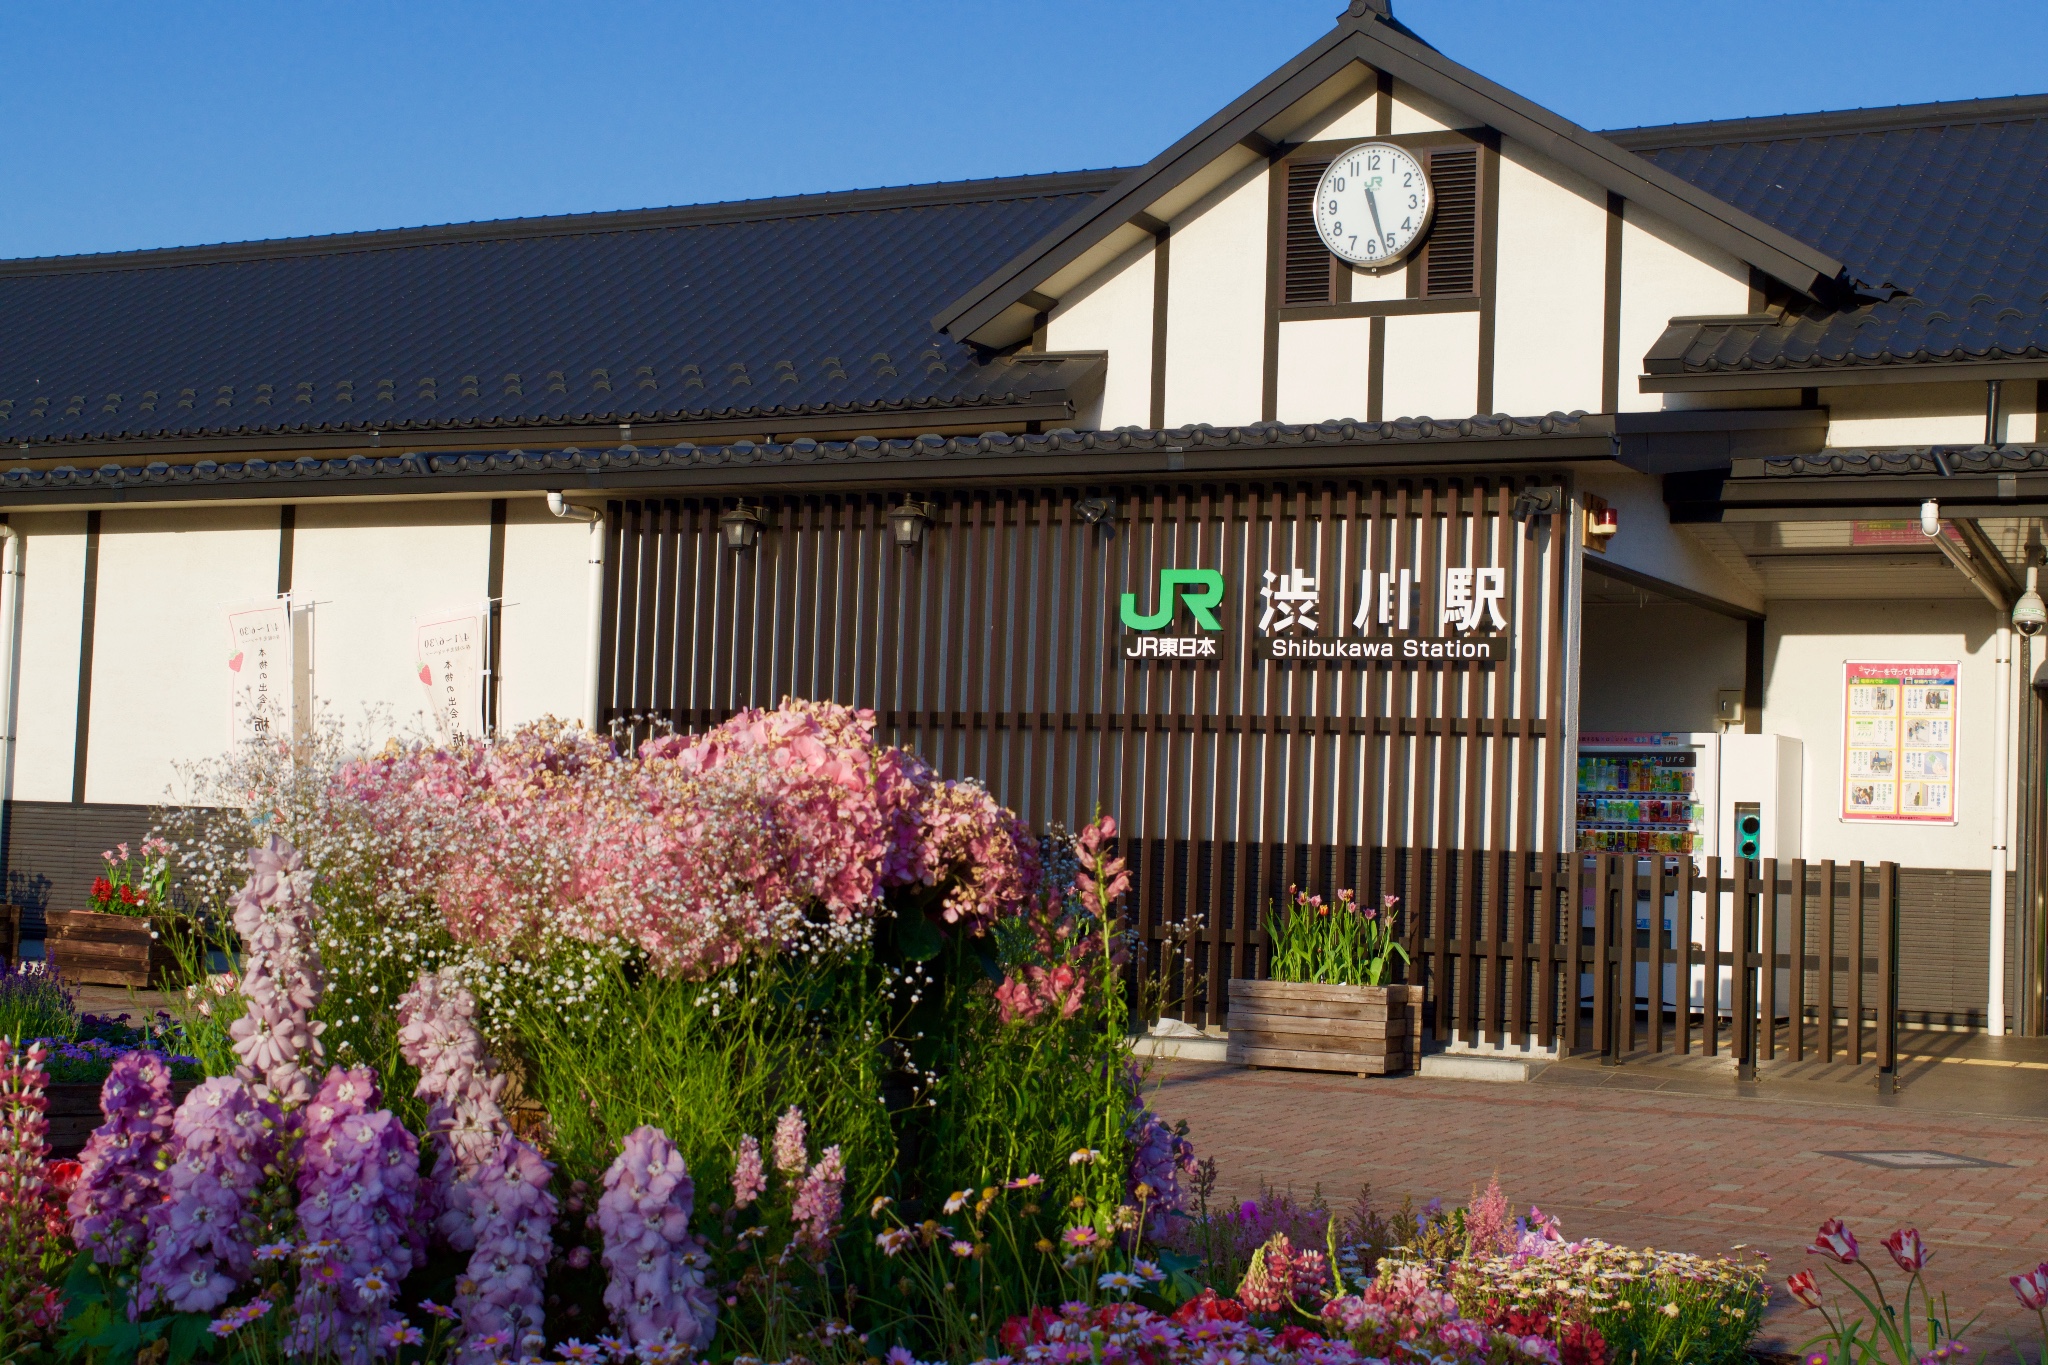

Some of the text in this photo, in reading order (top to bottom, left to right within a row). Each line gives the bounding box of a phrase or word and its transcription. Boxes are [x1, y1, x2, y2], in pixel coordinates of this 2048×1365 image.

[1350, 161, 1360, 177] 11
[1367, 154, 1381, 171] 12
[1333, 177, 1346, 192] 10
[1364, 176, 1383, 188] JR
[1403, 172, 1412, 188] 2
[1328, 200, 1338, 215] 9
[1408, 194, 1418, 210] 3
[1333, 221, 1343, 237] 8
[1401, 216, 1412, 232] 4
[1348, 235, 1358, 251] 7
[1367, 239, 1376, 255] 6
[1386, 232, 1396, 249] 5
[1120, 569, 1225, 630] JR
[1259, 567, 1507, 631] 渋川駅
[1127, 637, 1216, 657] JR東日本
[1272, 639, 1490, 658] Shibukawa Station
